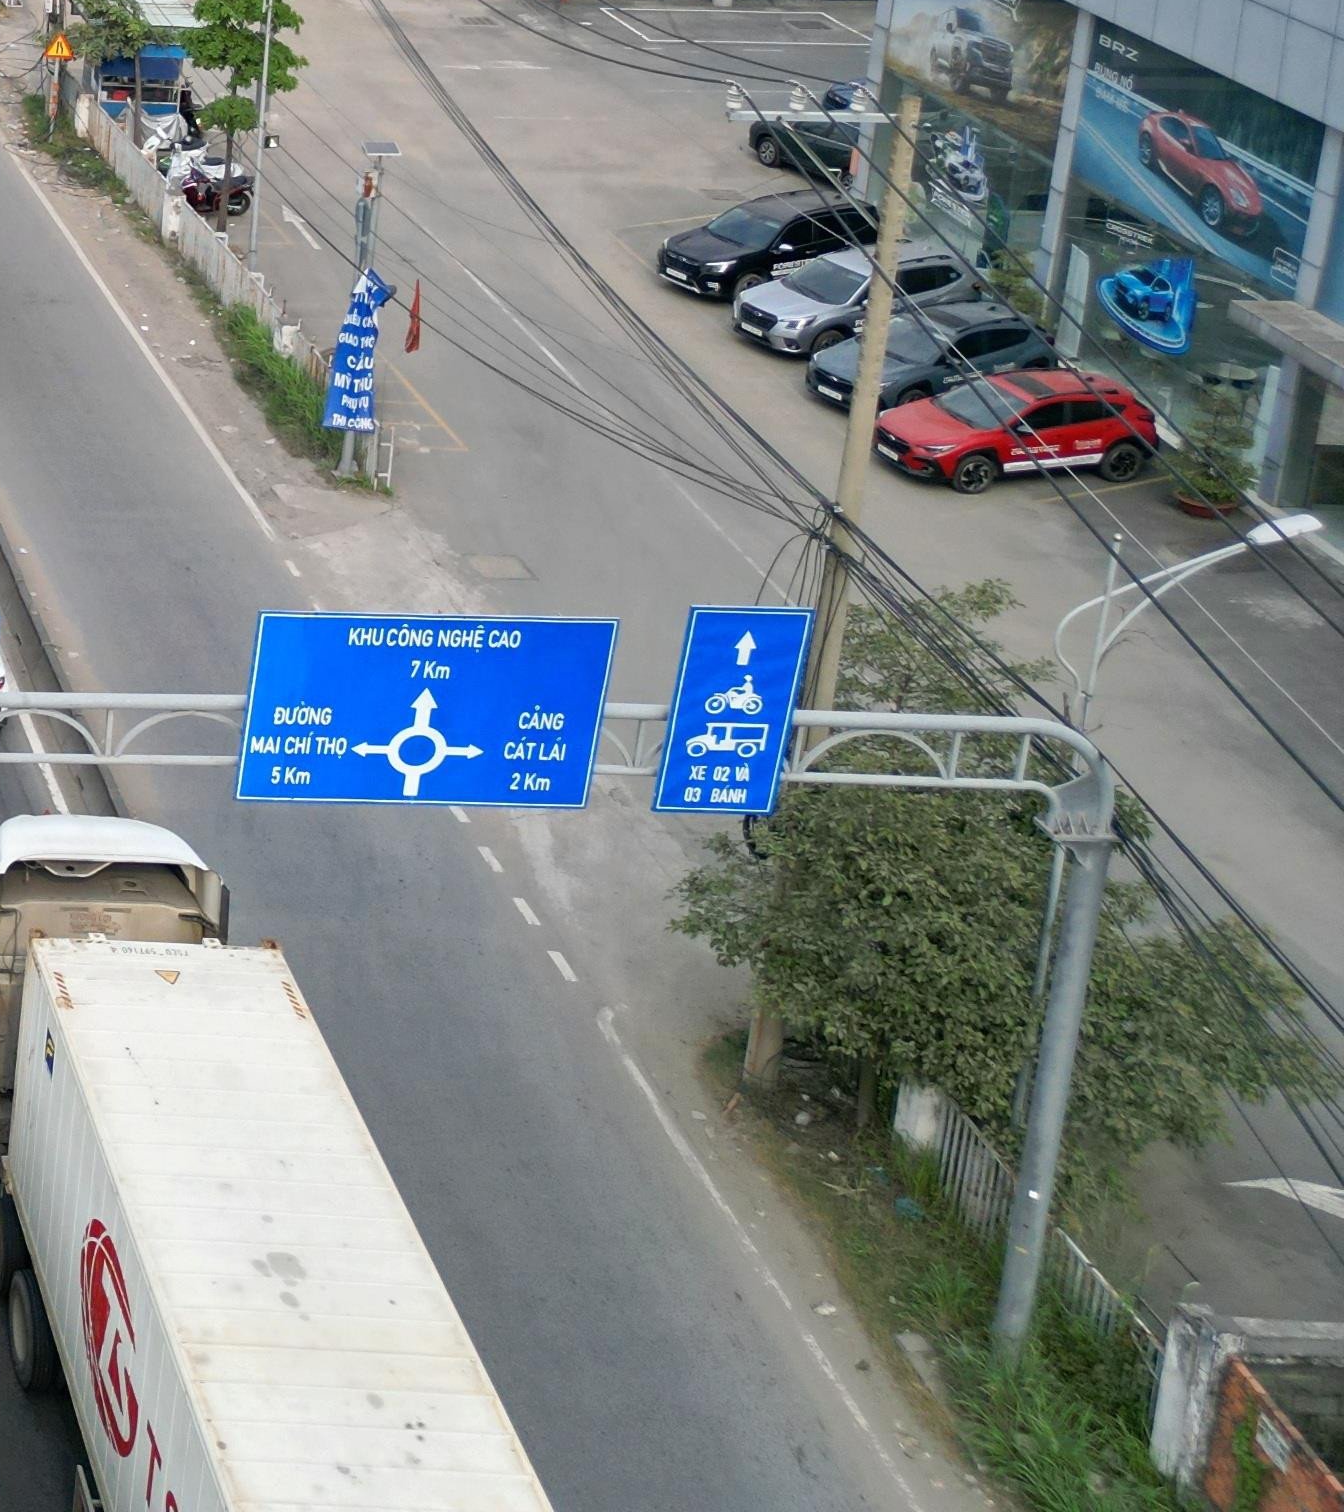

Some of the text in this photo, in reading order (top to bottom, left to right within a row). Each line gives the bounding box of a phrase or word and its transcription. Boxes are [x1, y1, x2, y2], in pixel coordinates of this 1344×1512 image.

[1099, 34, 1139, 62] BRZ
[348, 623, 521, 654] KHU CÔNG NGHỆ CAO
[411, 660, 450, 680] 7 Km
[273, 704, 332, 726] ĐƯỜNG
[518, 703, 564, 730] CẢNG
[250, 731, 348, 759] MAI CHÍ THỌ
[503, 736, 566, 762] CÁT LÁI
[271, 767, 311, 785] 5 Km
[510, 773, 551, 791] 2 Km
[689, 761, 750, 782] XE 02 VÀ
[684, 782, 747, 805] 03 BÁNH
